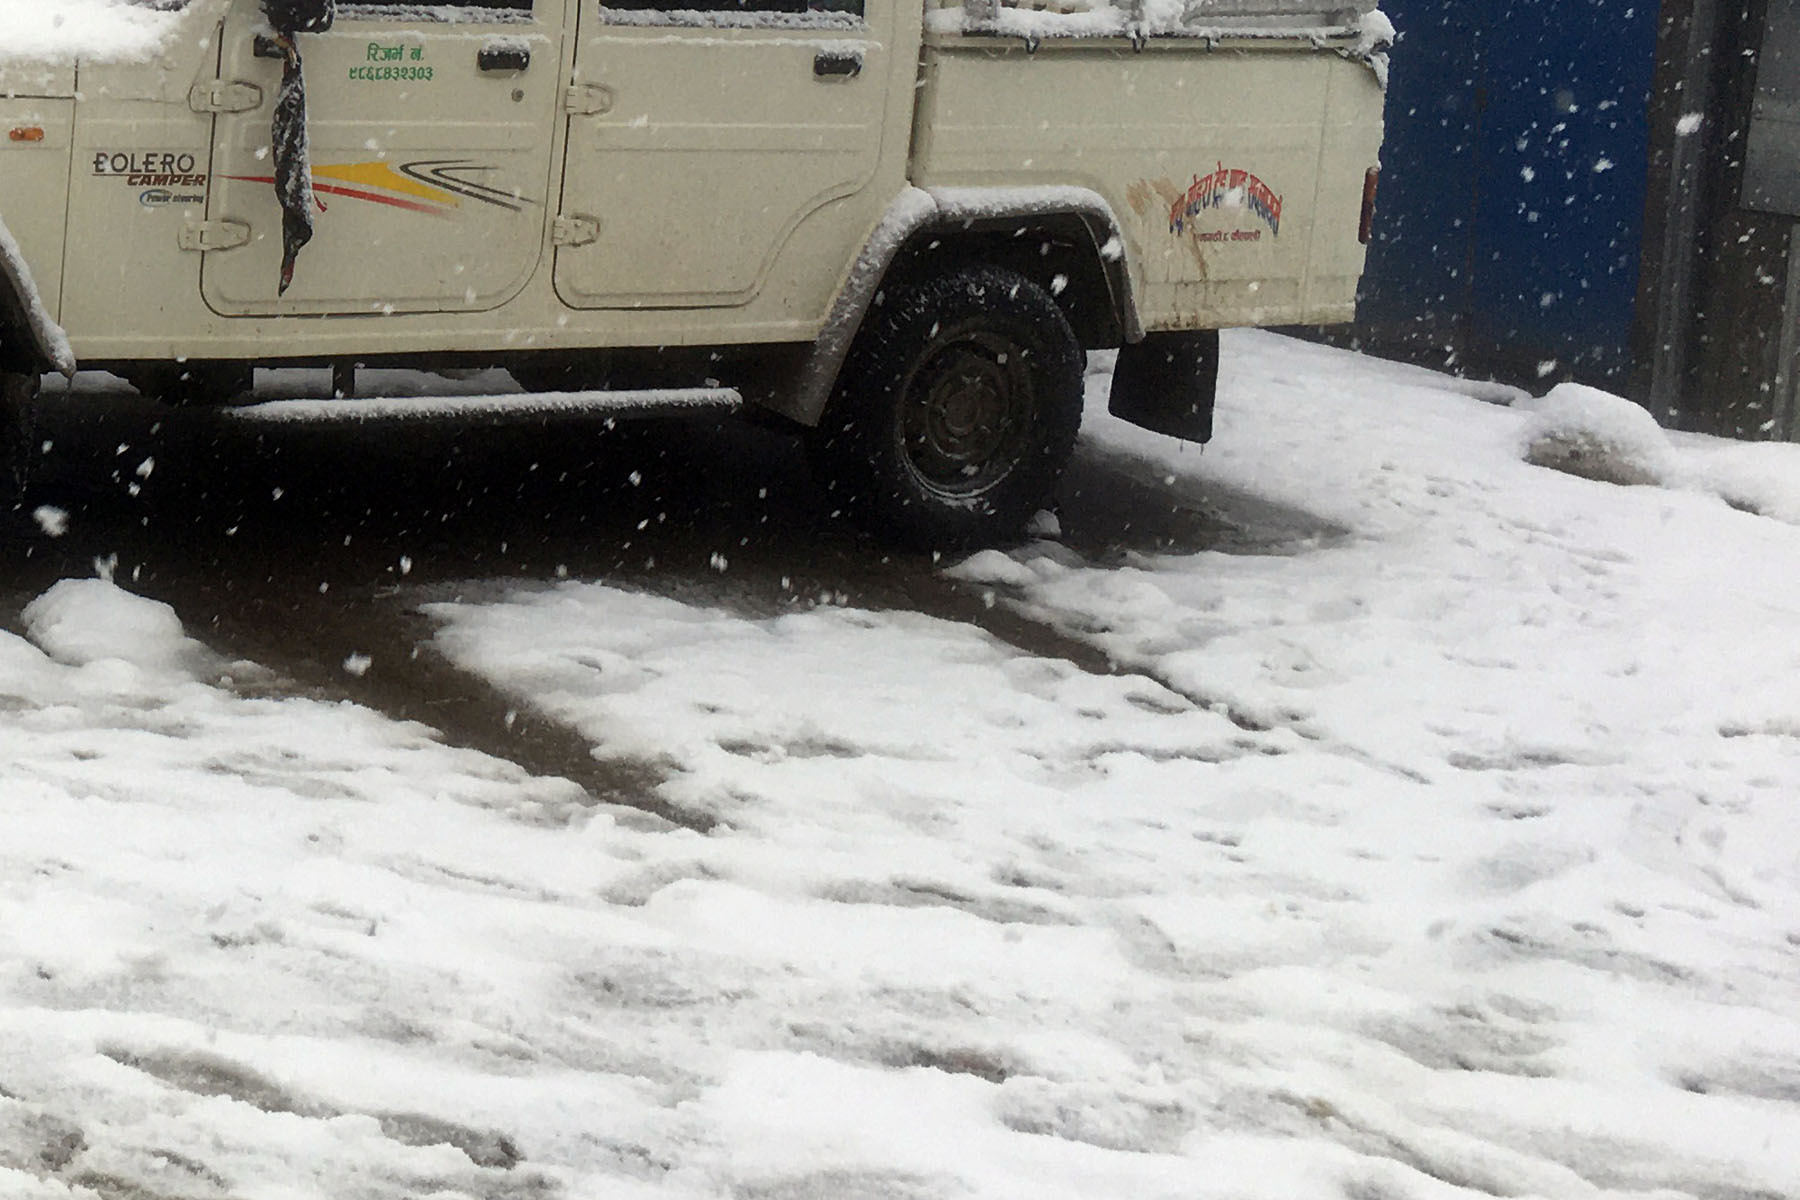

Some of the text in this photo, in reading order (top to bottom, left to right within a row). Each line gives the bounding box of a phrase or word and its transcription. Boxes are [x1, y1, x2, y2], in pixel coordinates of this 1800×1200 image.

[93, 153, 195, 175] BOLERO
[127, 173, 206, 186] CAMPER
[146, 194, 171, 203] Power
